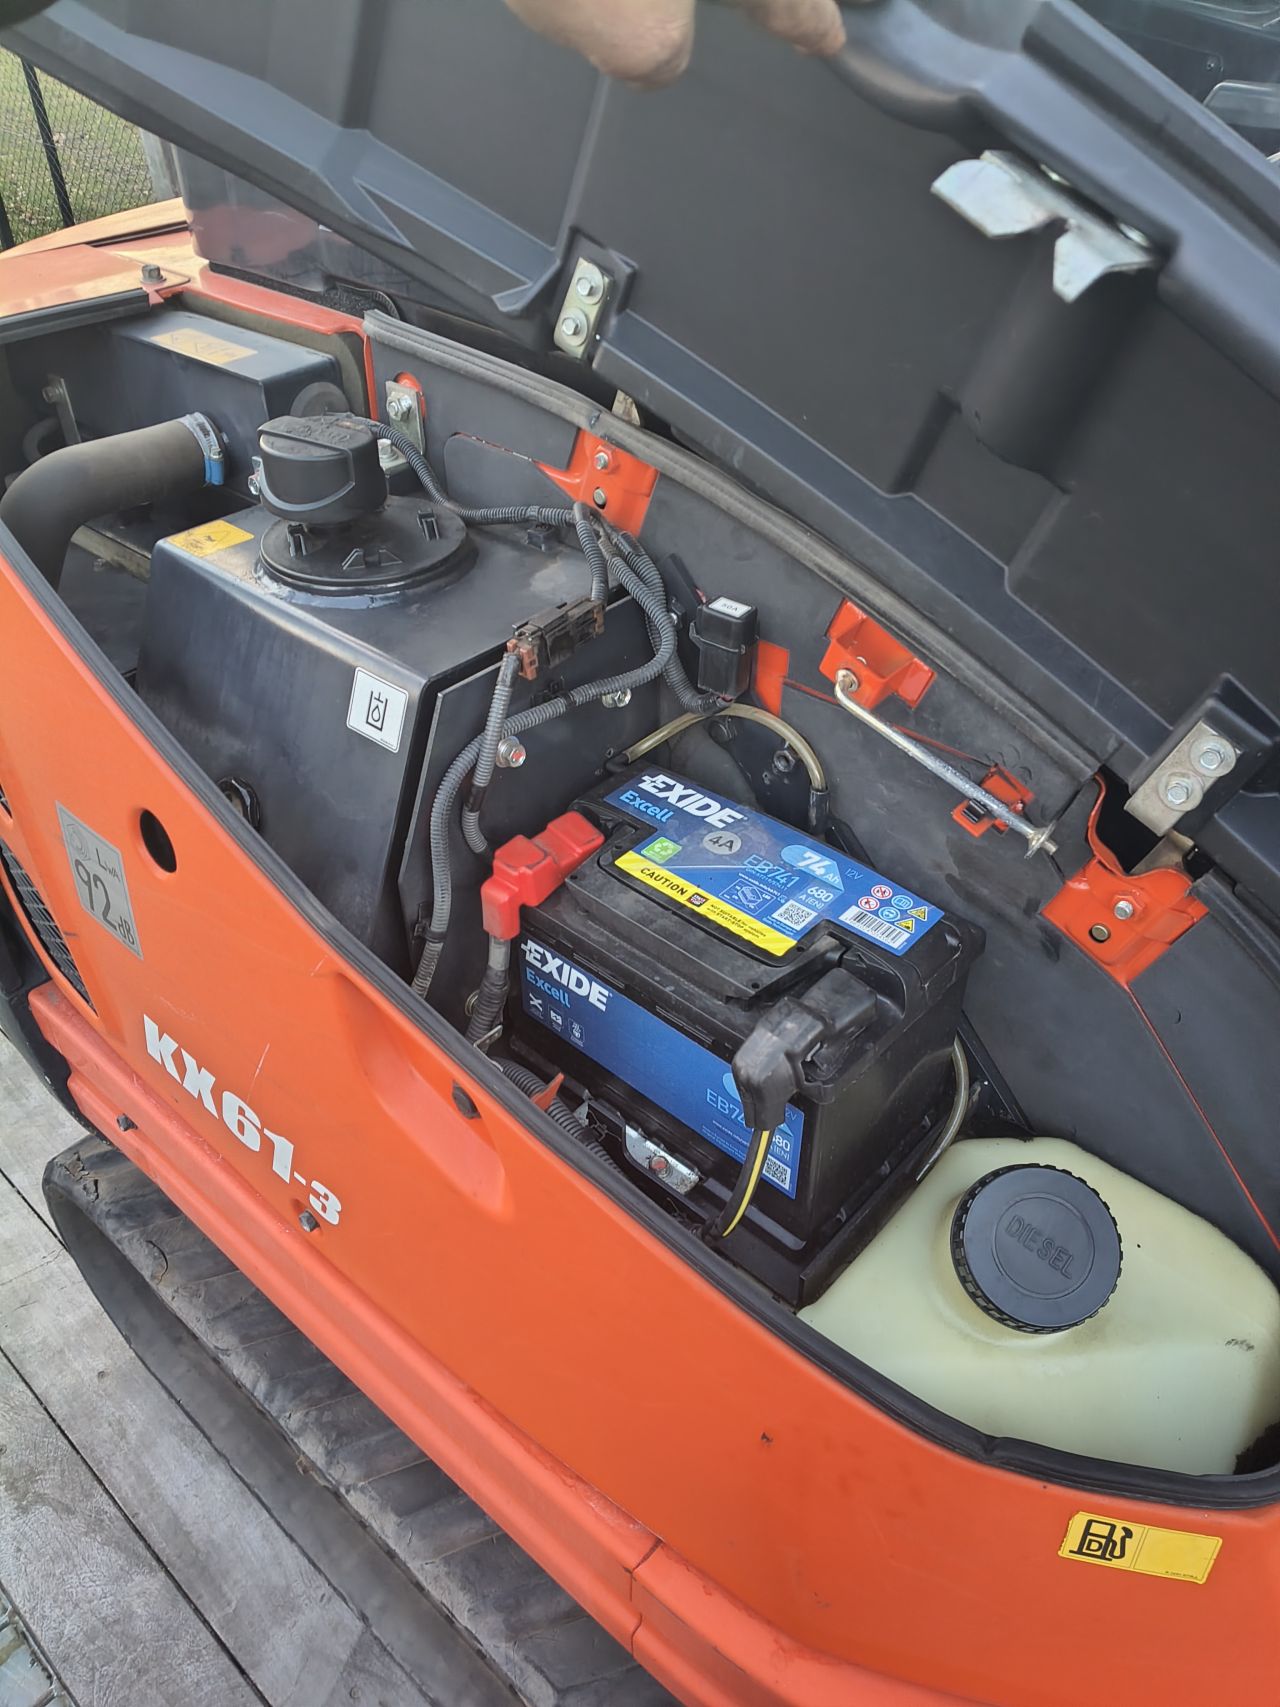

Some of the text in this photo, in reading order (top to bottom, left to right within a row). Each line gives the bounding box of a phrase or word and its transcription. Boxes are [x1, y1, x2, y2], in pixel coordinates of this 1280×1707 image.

[619, 790, 674, 823] Excell
[638, 774, 745, 829] EXIDE
[708, 835, 735, 852] 4A
[640, 867, 688, 896] CAUTION
[743, 854, 800, 888] EB741
[797, 851, 841, 884] 74 Ah
[845, 868, 863, 880] 12V
[75, 858, 135, 946] 92 dB
[807, 886, 834, 902] 680
[521, 939, 609, 1012] EXIDE
[526, 966, 571, 1009] Excell
[143, 1013, 342, 1226] KX61-3
[1005, 1214, 1074, 1280] DIESEL
